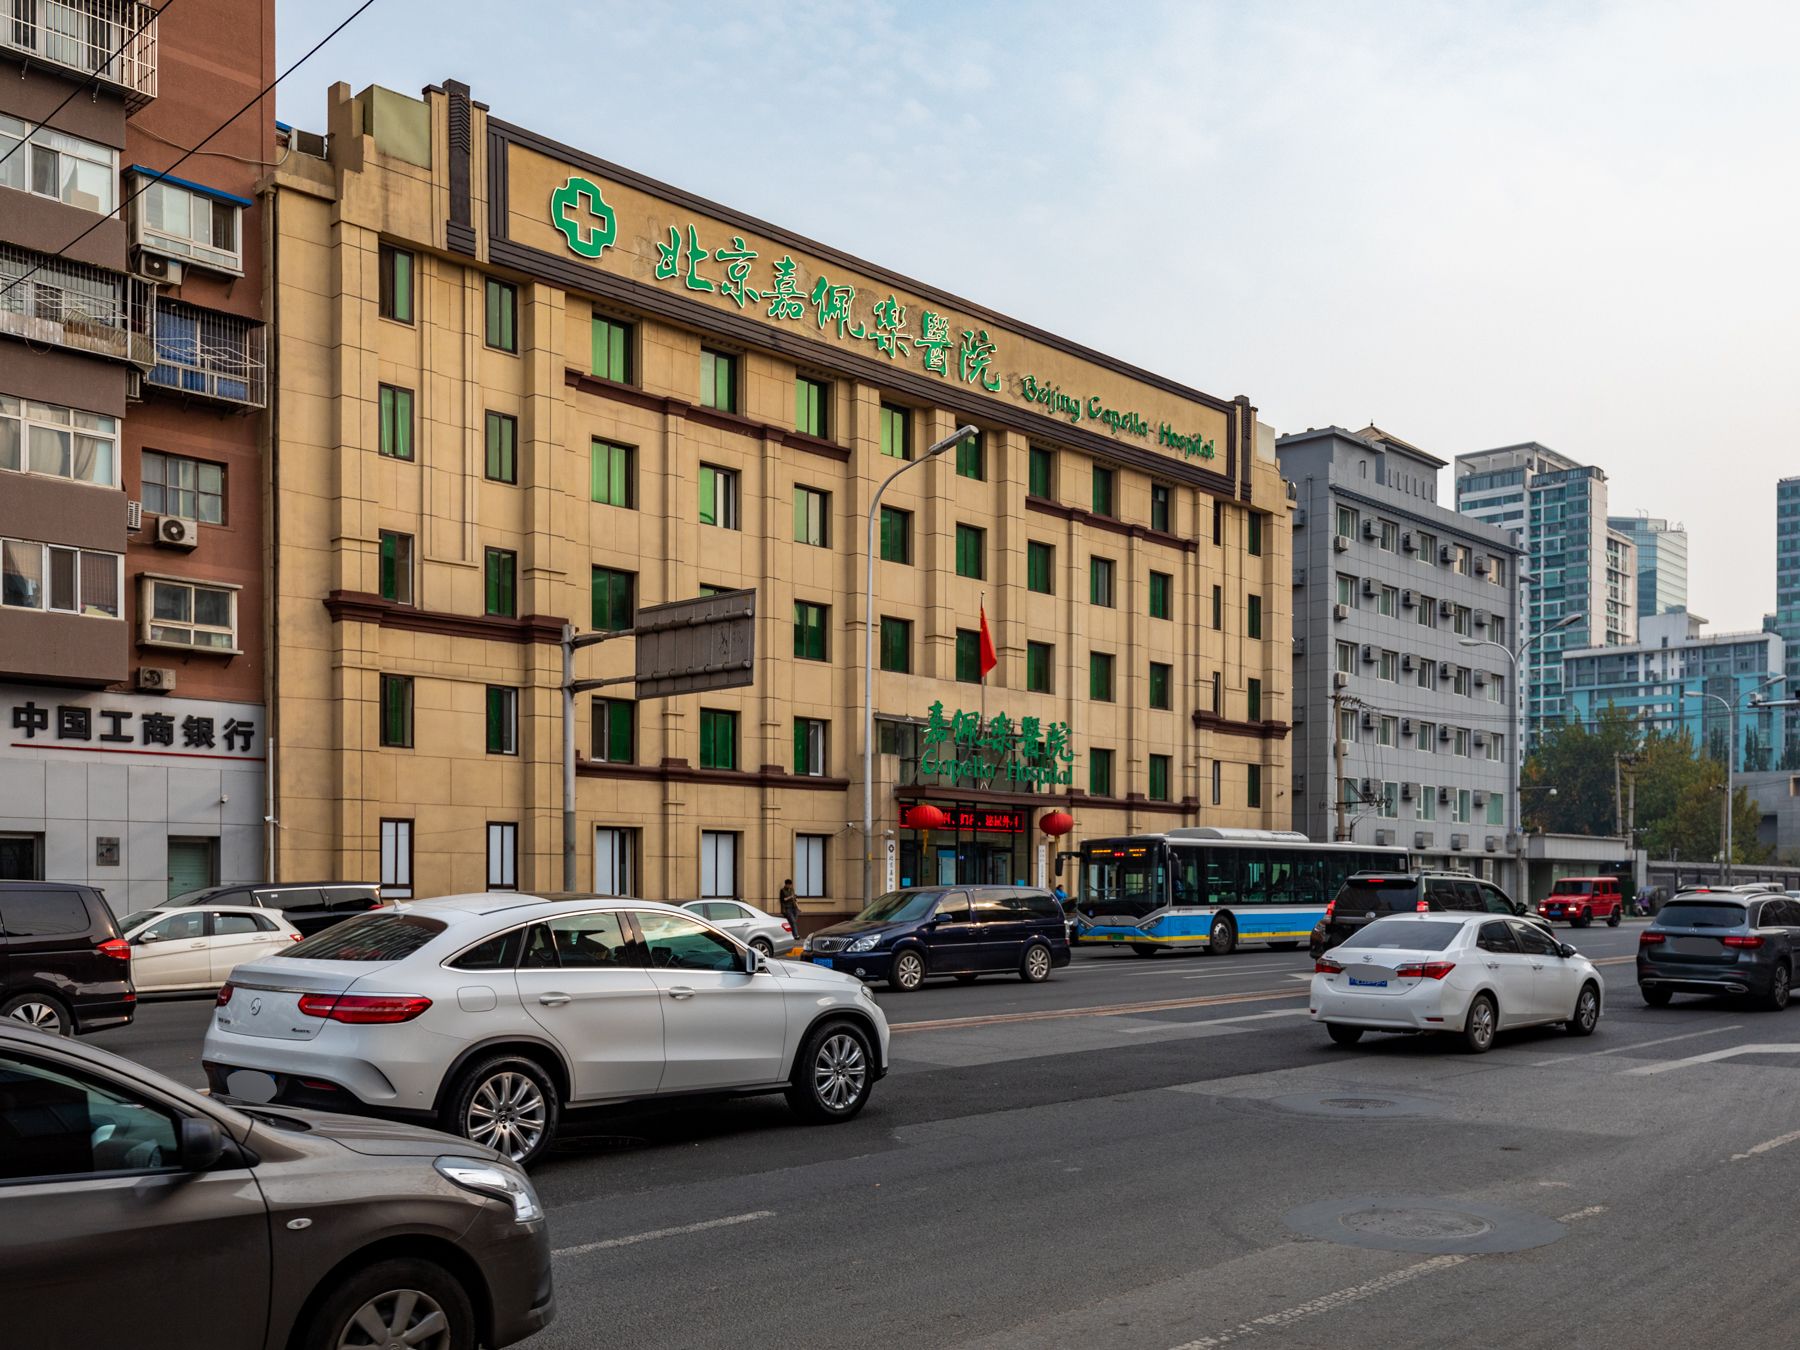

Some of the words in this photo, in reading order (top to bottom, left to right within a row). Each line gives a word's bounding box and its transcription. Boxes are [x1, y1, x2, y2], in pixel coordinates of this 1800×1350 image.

[1021, 375, 1081, 423] Beijing
[1087, 396, 1149, 437] Capella
[1158, 421, 1215, 460] Hospital
[13, 701, 255, 751] 中国工商银行
[921, 748, 996, 784] Capella
[1006, 757, 1073, 794] Hospital
